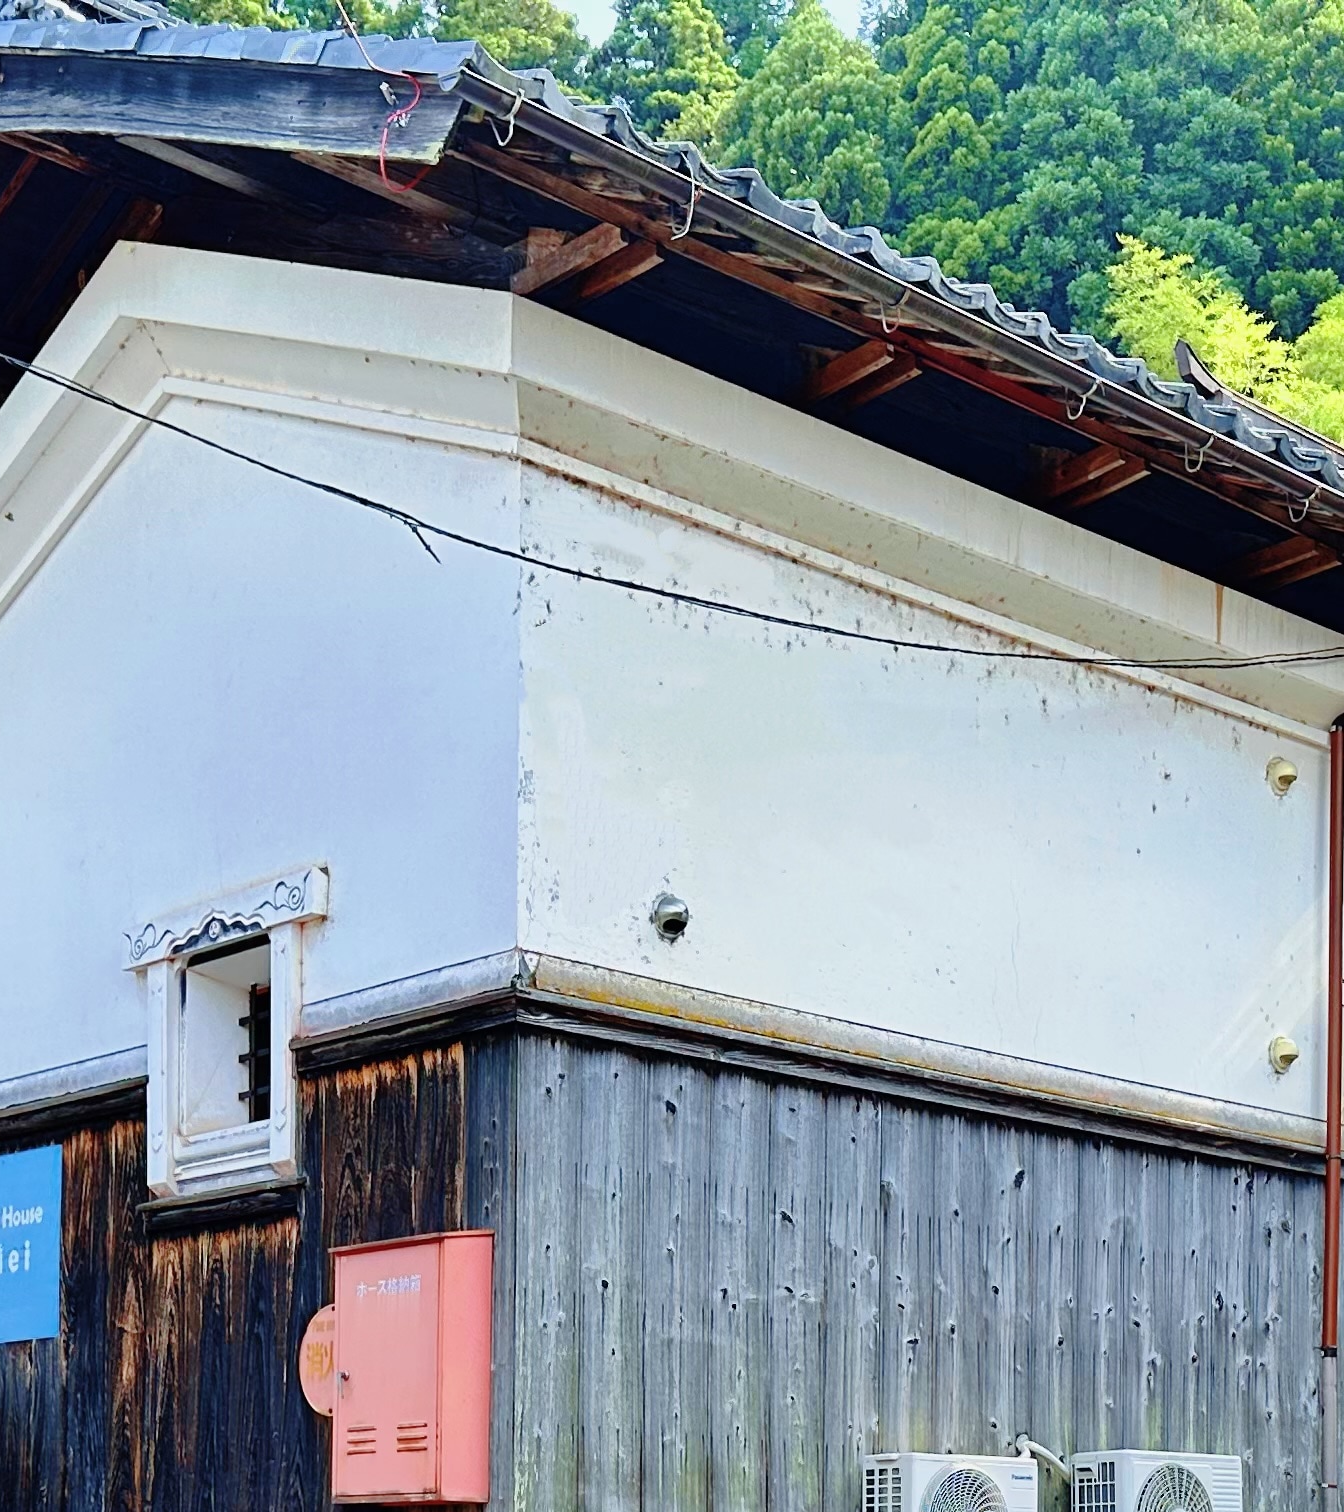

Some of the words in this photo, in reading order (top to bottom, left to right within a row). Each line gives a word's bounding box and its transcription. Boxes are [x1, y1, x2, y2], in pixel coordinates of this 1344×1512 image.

[1, 1205, 44, 1229] House
[356, 1274, 422, 1297] ホース格納箱
